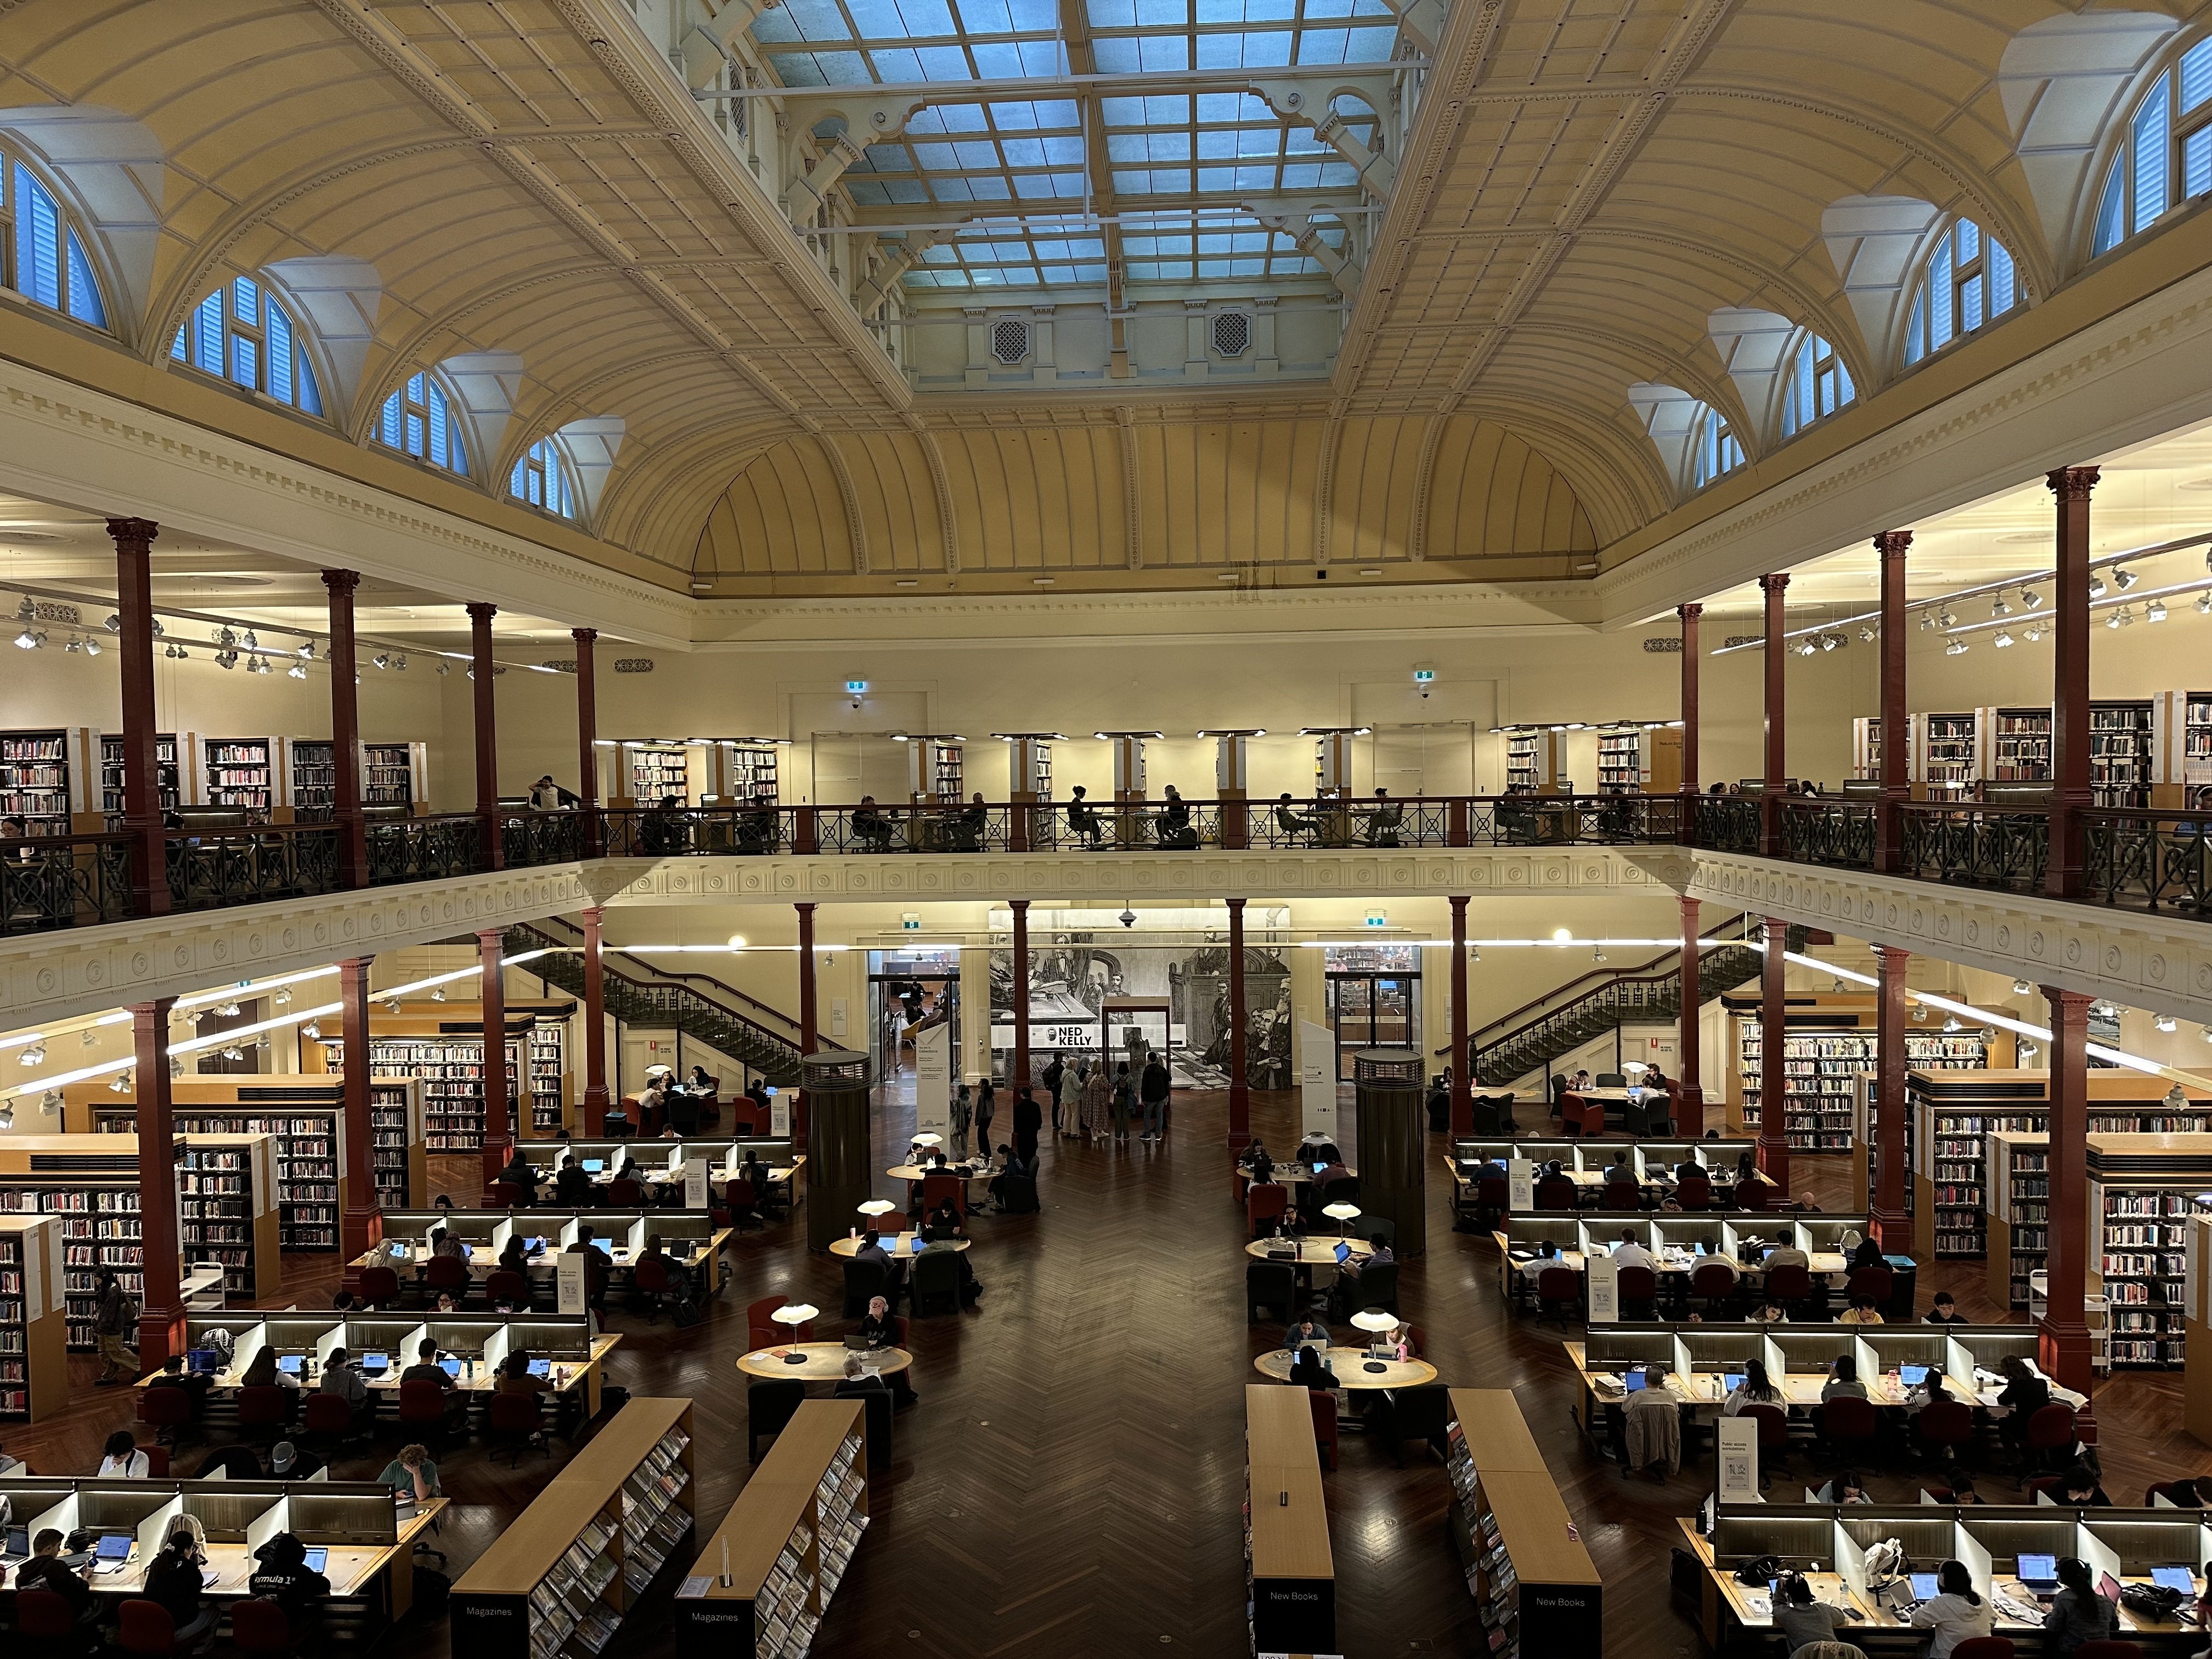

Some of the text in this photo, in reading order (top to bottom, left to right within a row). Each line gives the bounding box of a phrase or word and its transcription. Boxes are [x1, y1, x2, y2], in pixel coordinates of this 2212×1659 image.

[1059, 1027, 1082, 1036] NED
[1059, 1036, 1092, 1045] KELLY
[1271, 1592, 1318, 1601] New Books
[1537, 1597, 1585, 1607] New Books
[467, 1607, 512, 1617] Magazines
[692, 1612, 738, 1623] Magazines
